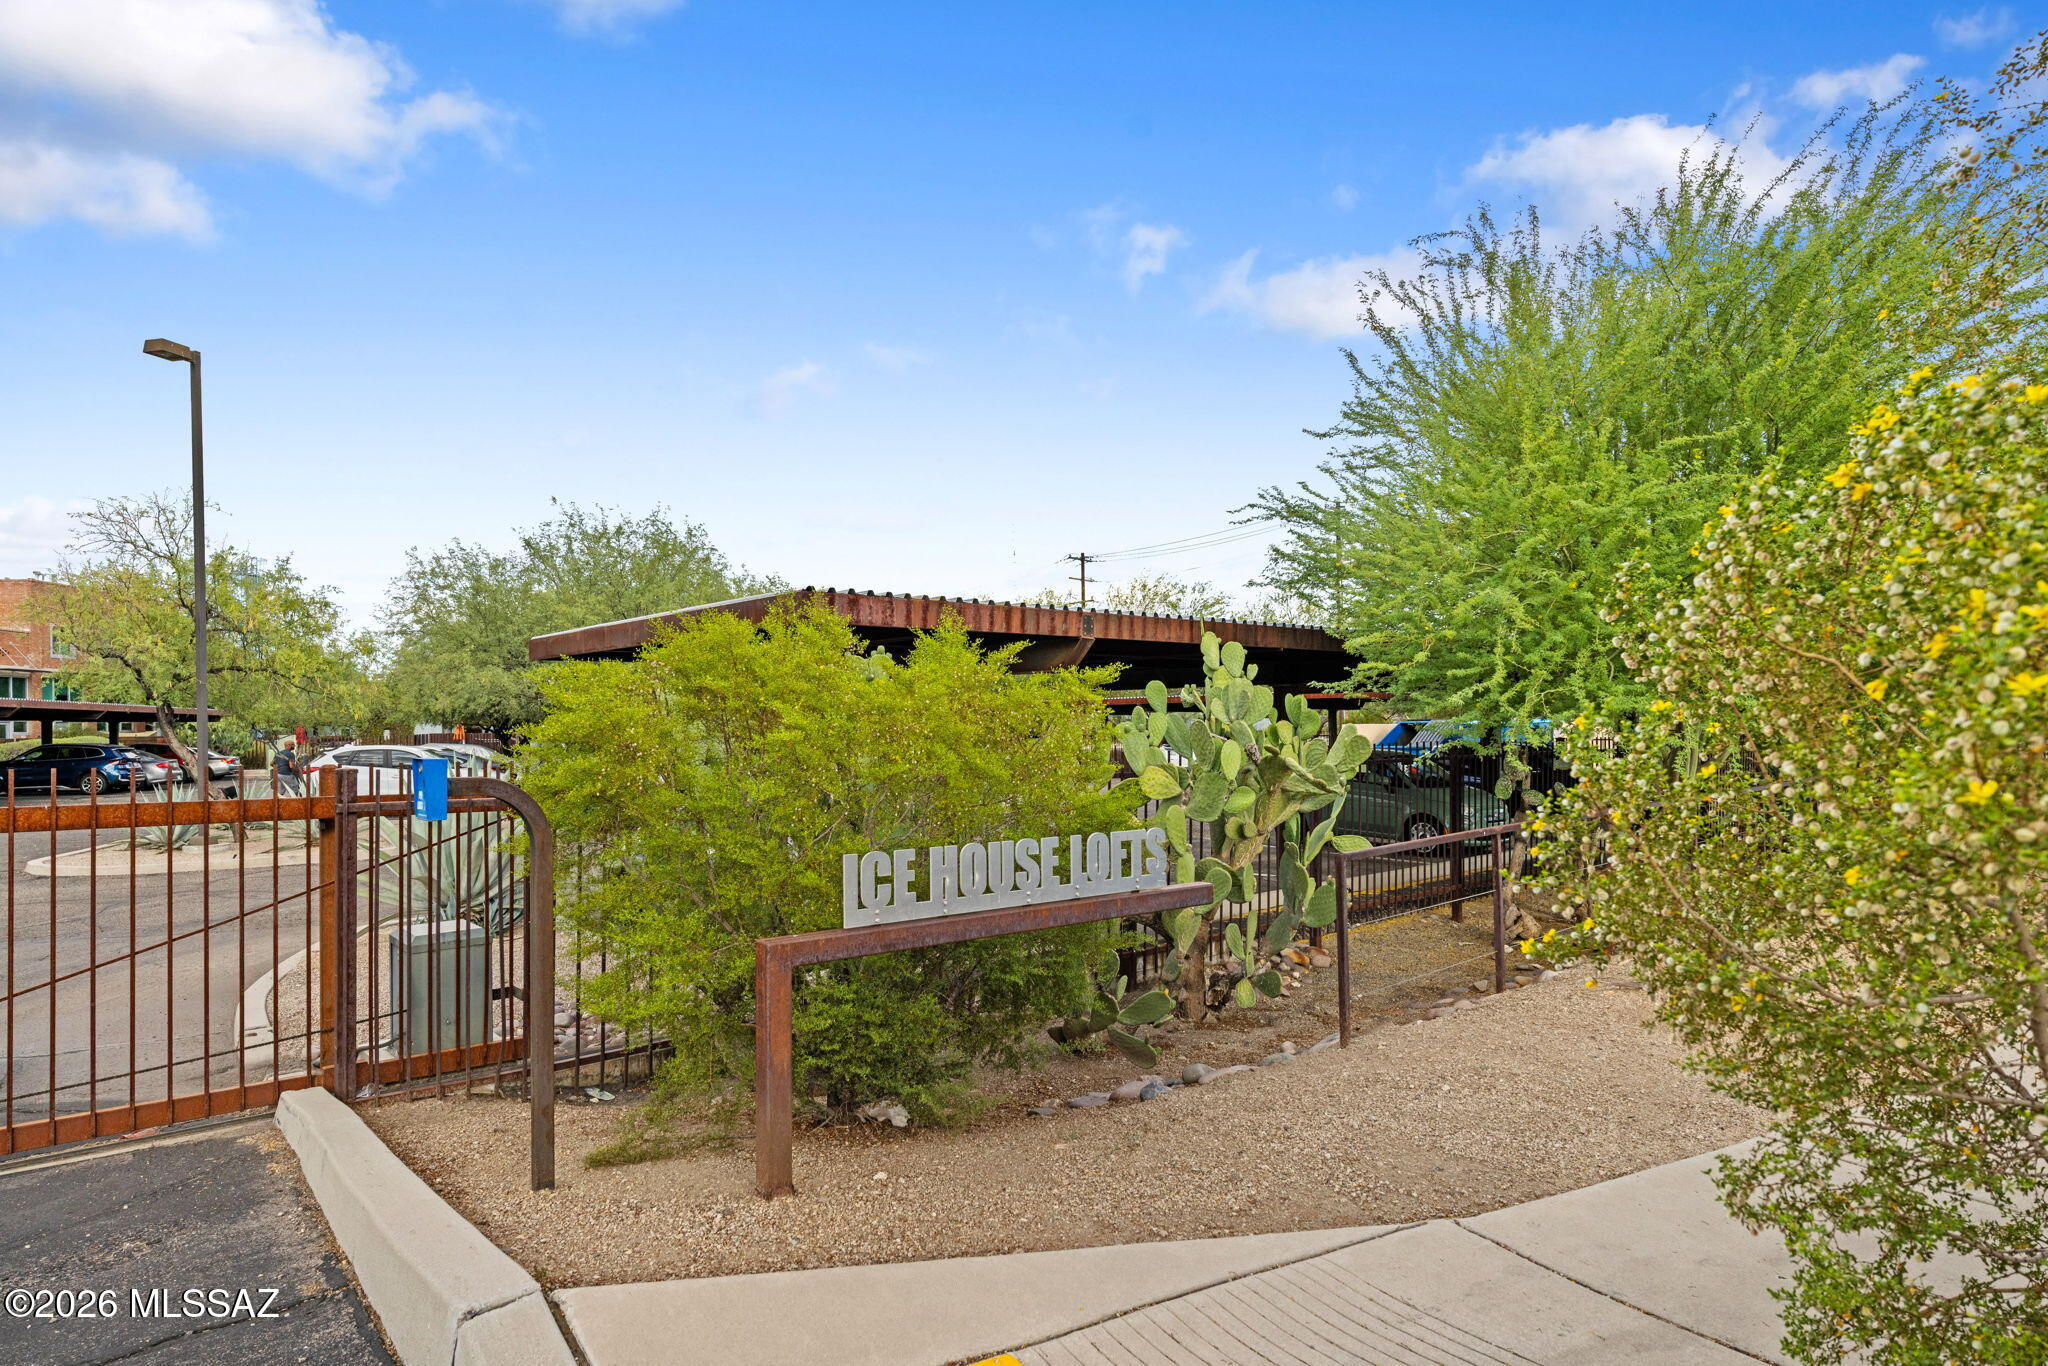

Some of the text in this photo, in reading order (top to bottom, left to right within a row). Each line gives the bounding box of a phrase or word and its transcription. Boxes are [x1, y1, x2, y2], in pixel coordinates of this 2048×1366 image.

[843, 827, 1168, 912] ICE HOUSE LOFTS
